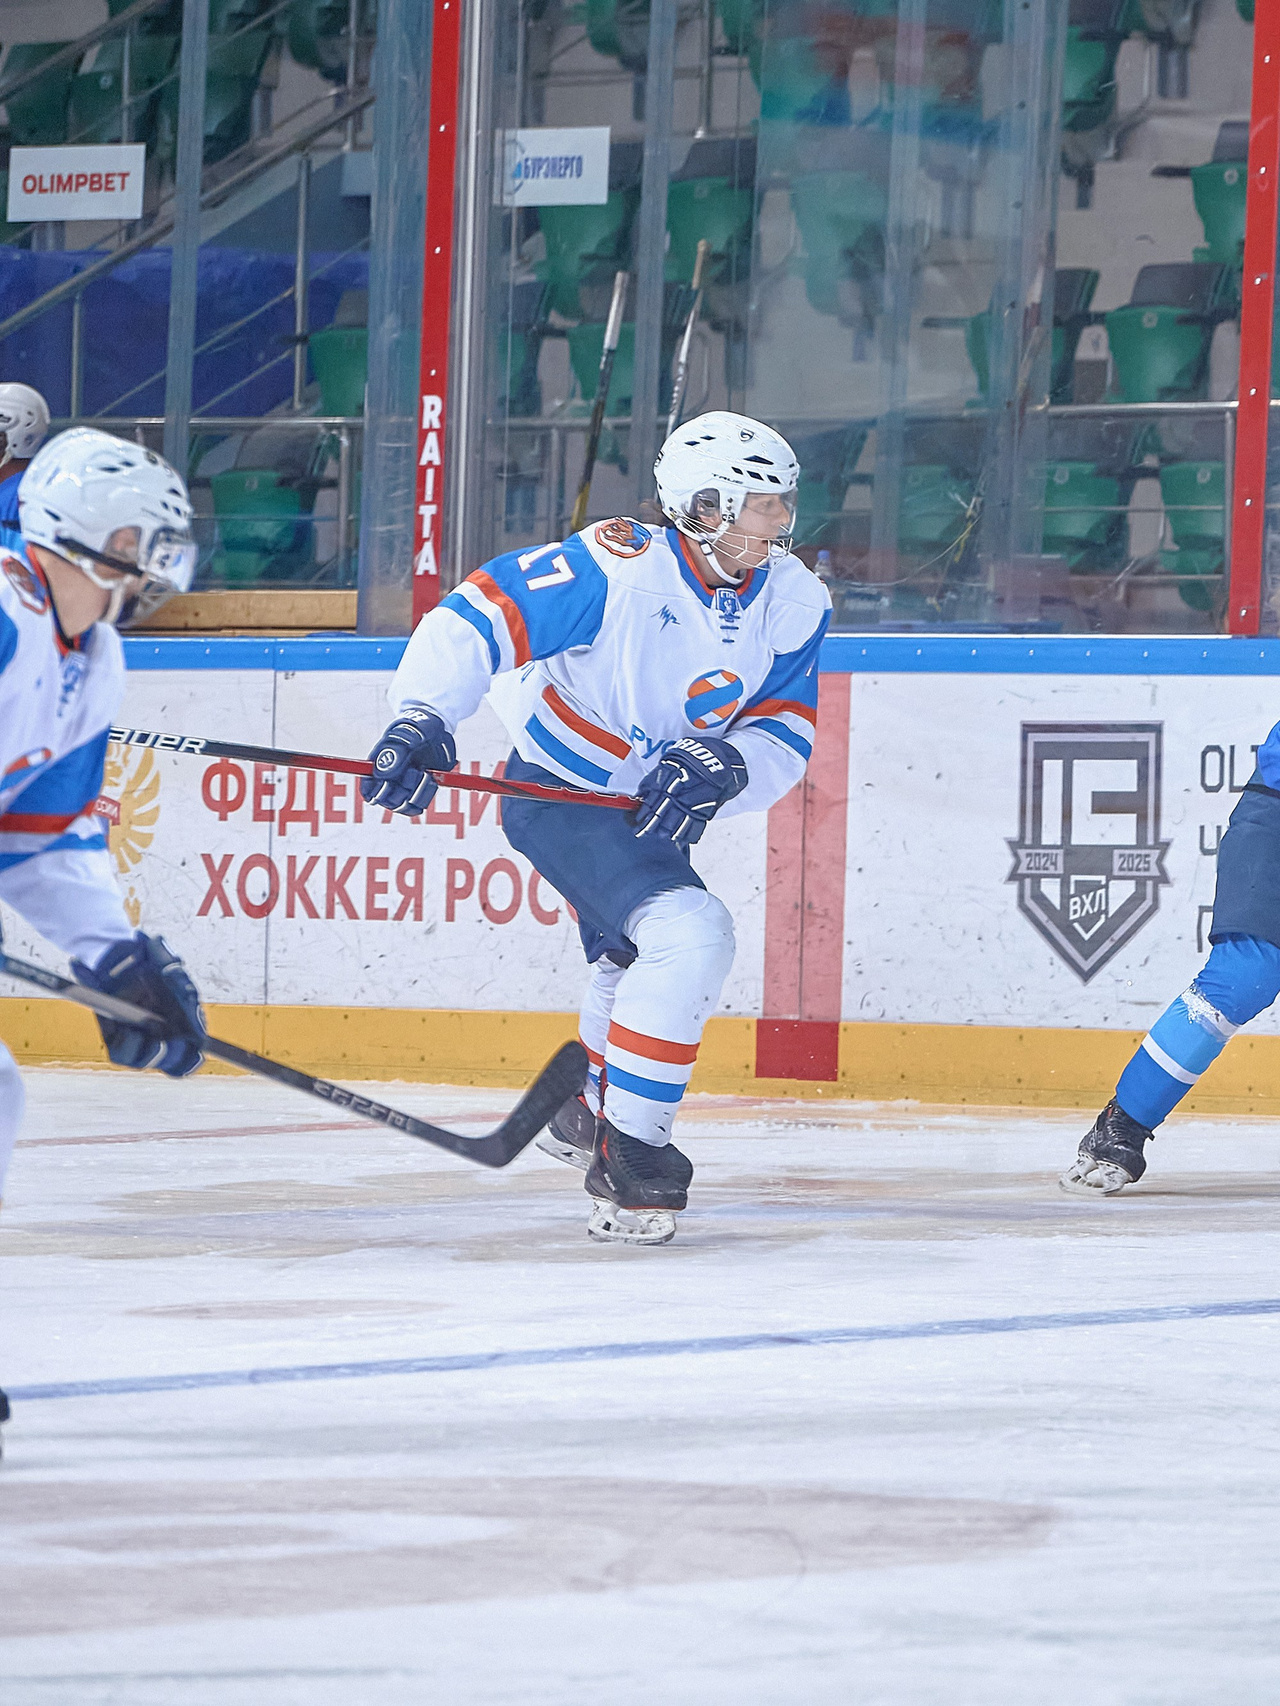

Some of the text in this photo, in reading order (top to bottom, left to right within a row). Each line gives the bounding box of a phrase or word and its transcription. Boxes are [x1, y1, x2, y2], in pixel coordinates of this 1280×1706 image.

[22, 172, 130, 195] OLIMPBET
[415, 394, 443, 576] RAITA
[517, 541, 576, 591] 17
[108, 726, 206, 755] AUER
[672, 738, 725, 774] RIOR
[1025, 852, 1151, 872] 2024 2025
[196, 852, 580, 926] ХОККЕЯ РОС
[1068, 887, 1106, 920] ВХЛ
